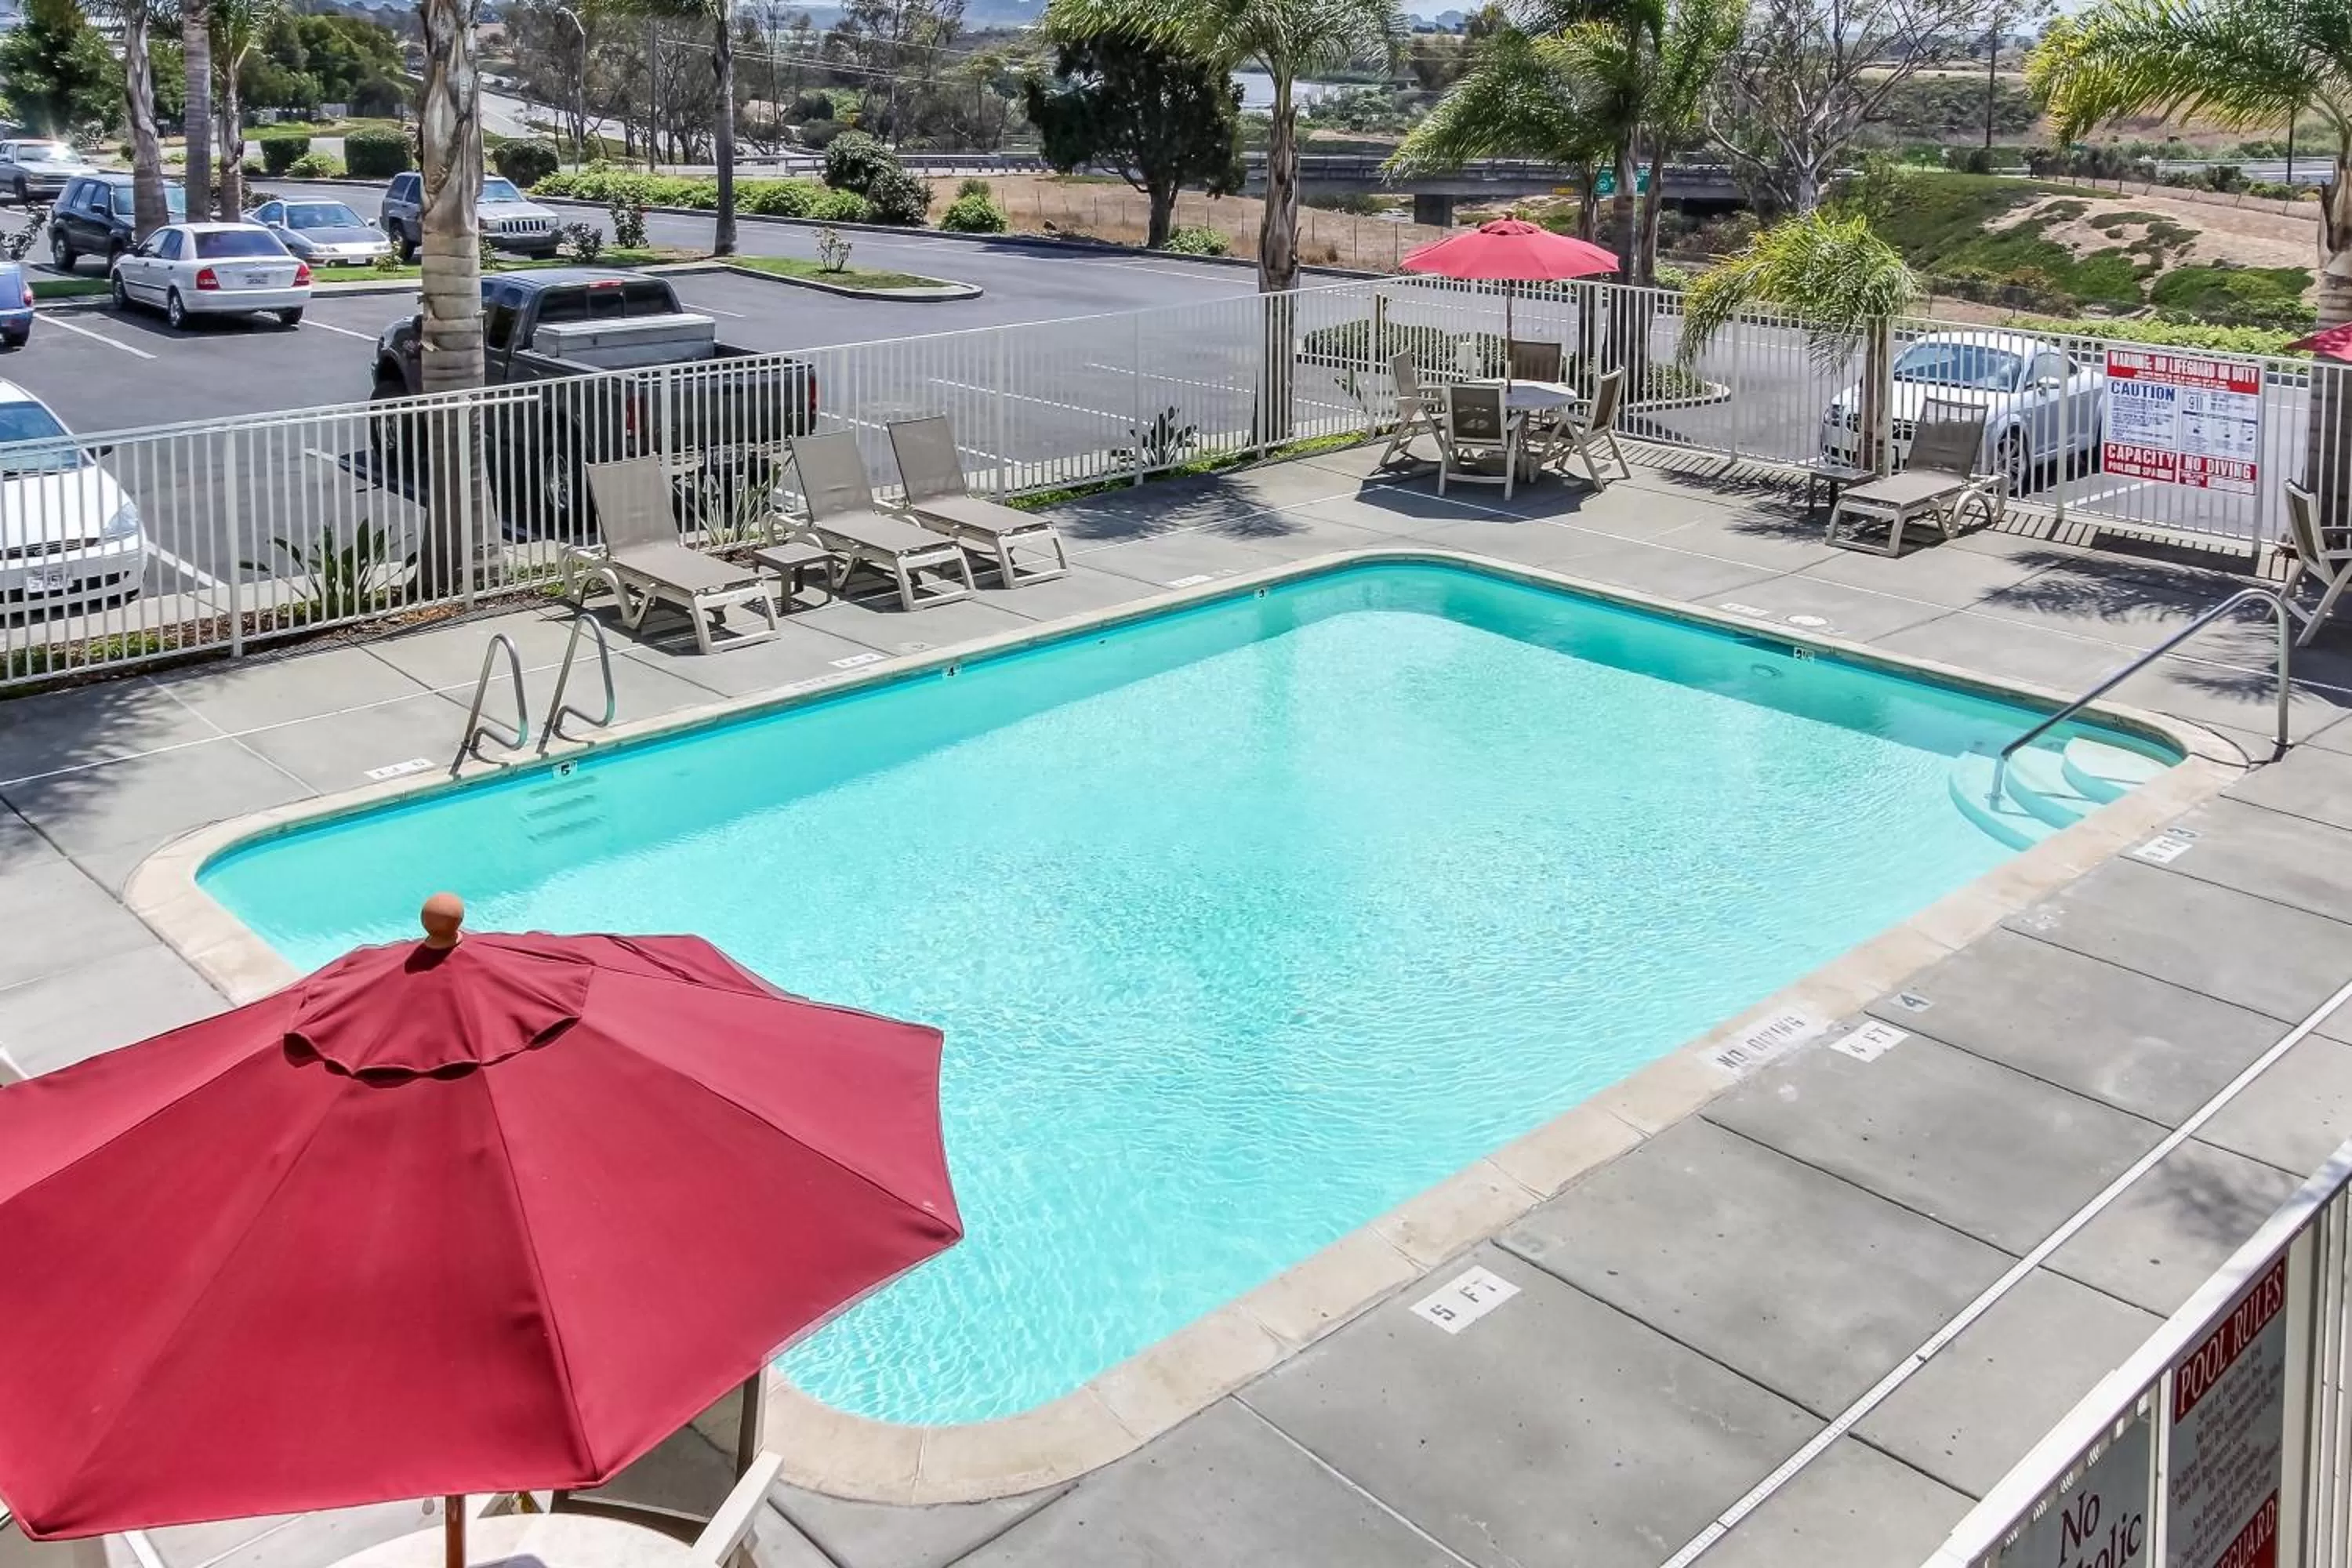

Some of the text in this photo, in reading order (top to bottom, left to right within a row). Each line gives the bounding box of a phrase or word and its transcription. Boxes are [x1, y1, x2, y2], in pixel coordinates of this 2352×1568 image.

[2169, 358, 2215, 379] LIFEGUARD
[2232, 366, 2257, 383] DUTY
[2111, 381, 2176, 401] CAUTION
[2188, 396, 2204, 411] 911
[2107, 445, 2175, 468] CAPACITY
[2185, 456, 2201, 471] NO
[2206, 459, 2251, 479] DIVING
[1900, 993, 1929, 1007] 4
[1715, 1015, 1806, 1069] NO DIVING
[1863, 1027, 1892, 1044] FT
[1429, 1277, 1497, 1321] 5 FT
[2180, 1327, 2227, 1414] POOL
[2233, 1265, 2282, 1355] RULES
[2057, 1490, 2100, 1568] No
